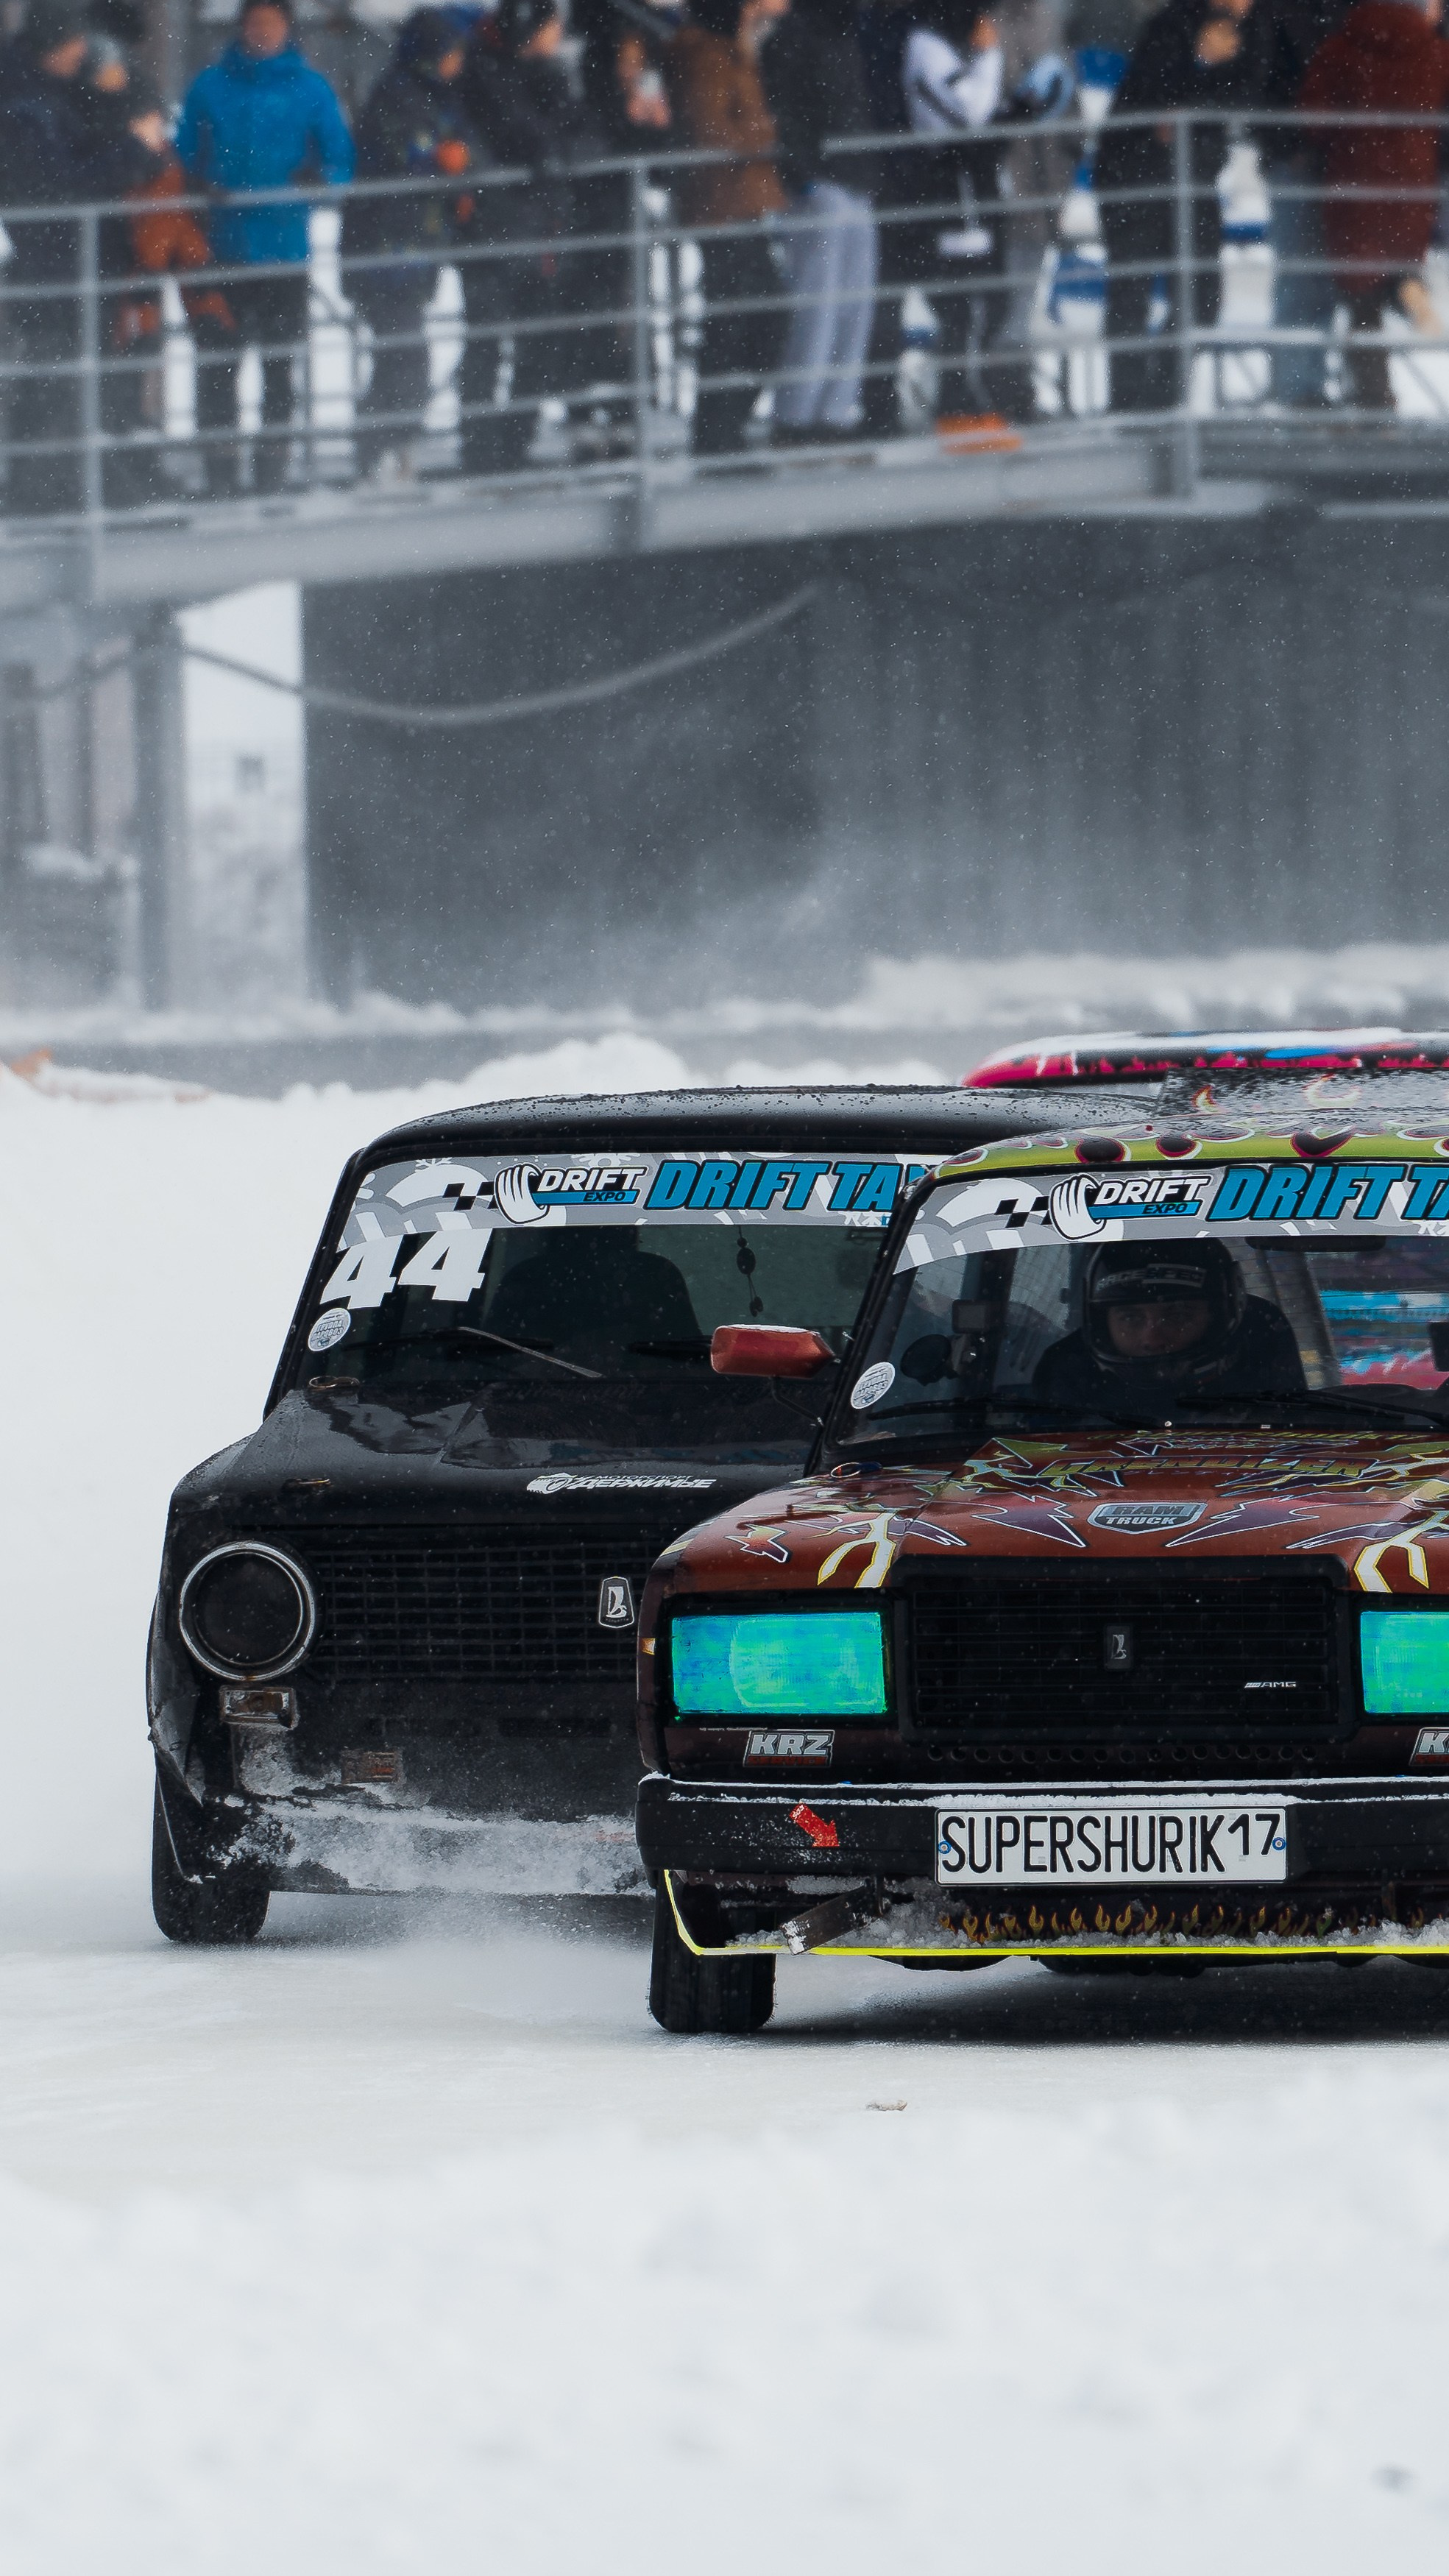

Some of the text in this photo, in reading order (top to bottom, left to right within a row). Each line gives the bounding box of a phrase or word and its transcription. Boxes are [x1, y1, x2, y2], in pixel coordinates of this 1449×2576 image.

[536, 1168, 645, 1192] DRIFT
[644, 1161, 935, 1211] DRIFT TA
[1094, 1178, 1210, 1205] DRIFT
[582, 1192, 626, 1202] EXPO
[1206, 1164, 1408, 1220] DRIFT
[1141, 1203, 1188, 1214] EXPO
[319, 1229, 497, 1309] 44
[1105, 1517, 1177, 1525] TRUCK
[1111, 1506, 1185, 1515] RAM
[749, 1733, 830, 1755] KRZ
